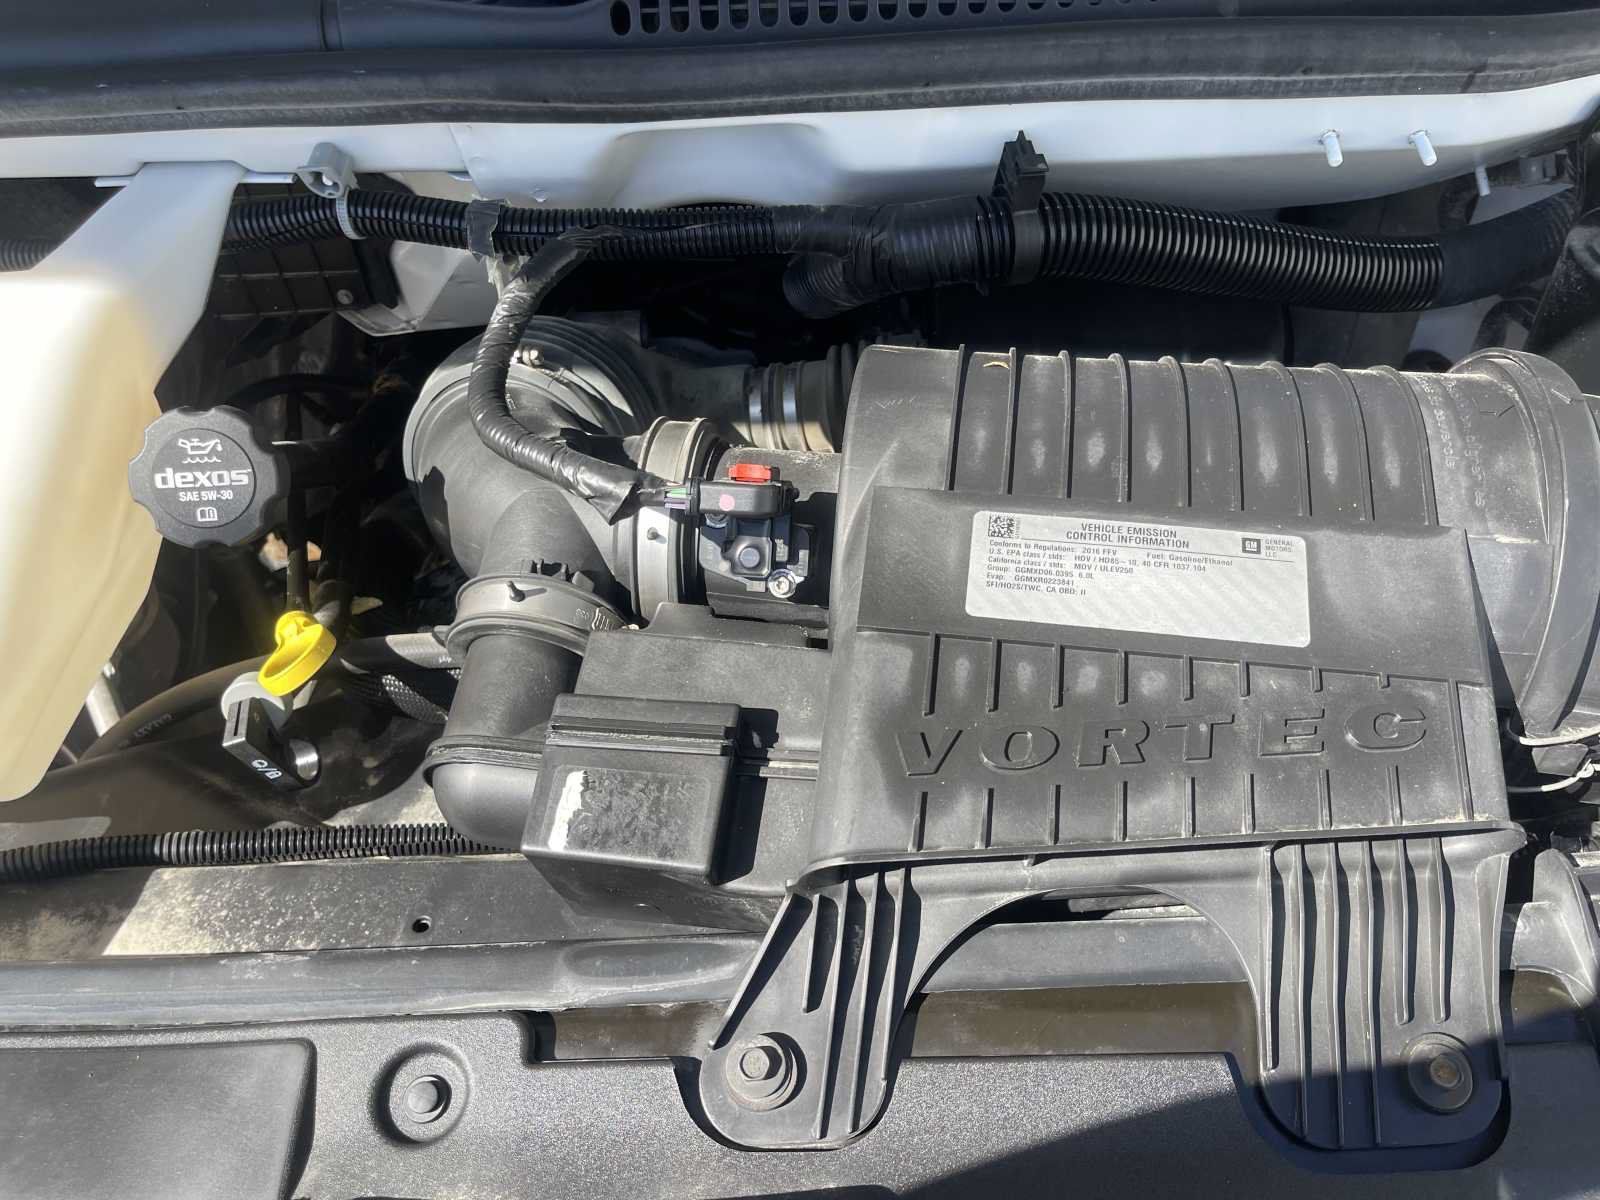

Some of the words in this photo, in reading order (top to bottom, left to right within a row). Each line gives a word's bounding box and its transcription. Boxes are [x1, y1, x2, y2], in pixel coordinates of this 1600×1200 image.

[154, 467, 250, 489] dexos
[179, 491, 200, 502] SAE
[200, 490, 233, 501] 5W-30
[1081, 523, 1123, 534] VEHICLE
[1127, 526, 1177, 538] EMISSION
[1066, 531, 1113, 543] CONTROL
[1117, 535, 1190, 549] INFORMATION
[1264, 539, 1295, 547] GENERAL
[989, 539, 1022, 549] Conforms
[1082, 547, 1100, 555] 2016
[1102, 548, 1118, 556] FFV
[988, 556, 1022, 565] California
[1153, 561, 1170, 569] CFR
[1168, 553, 1233, 567] Gasoline/Ethanol
[896, 706, 1427, 777] VORTEC
